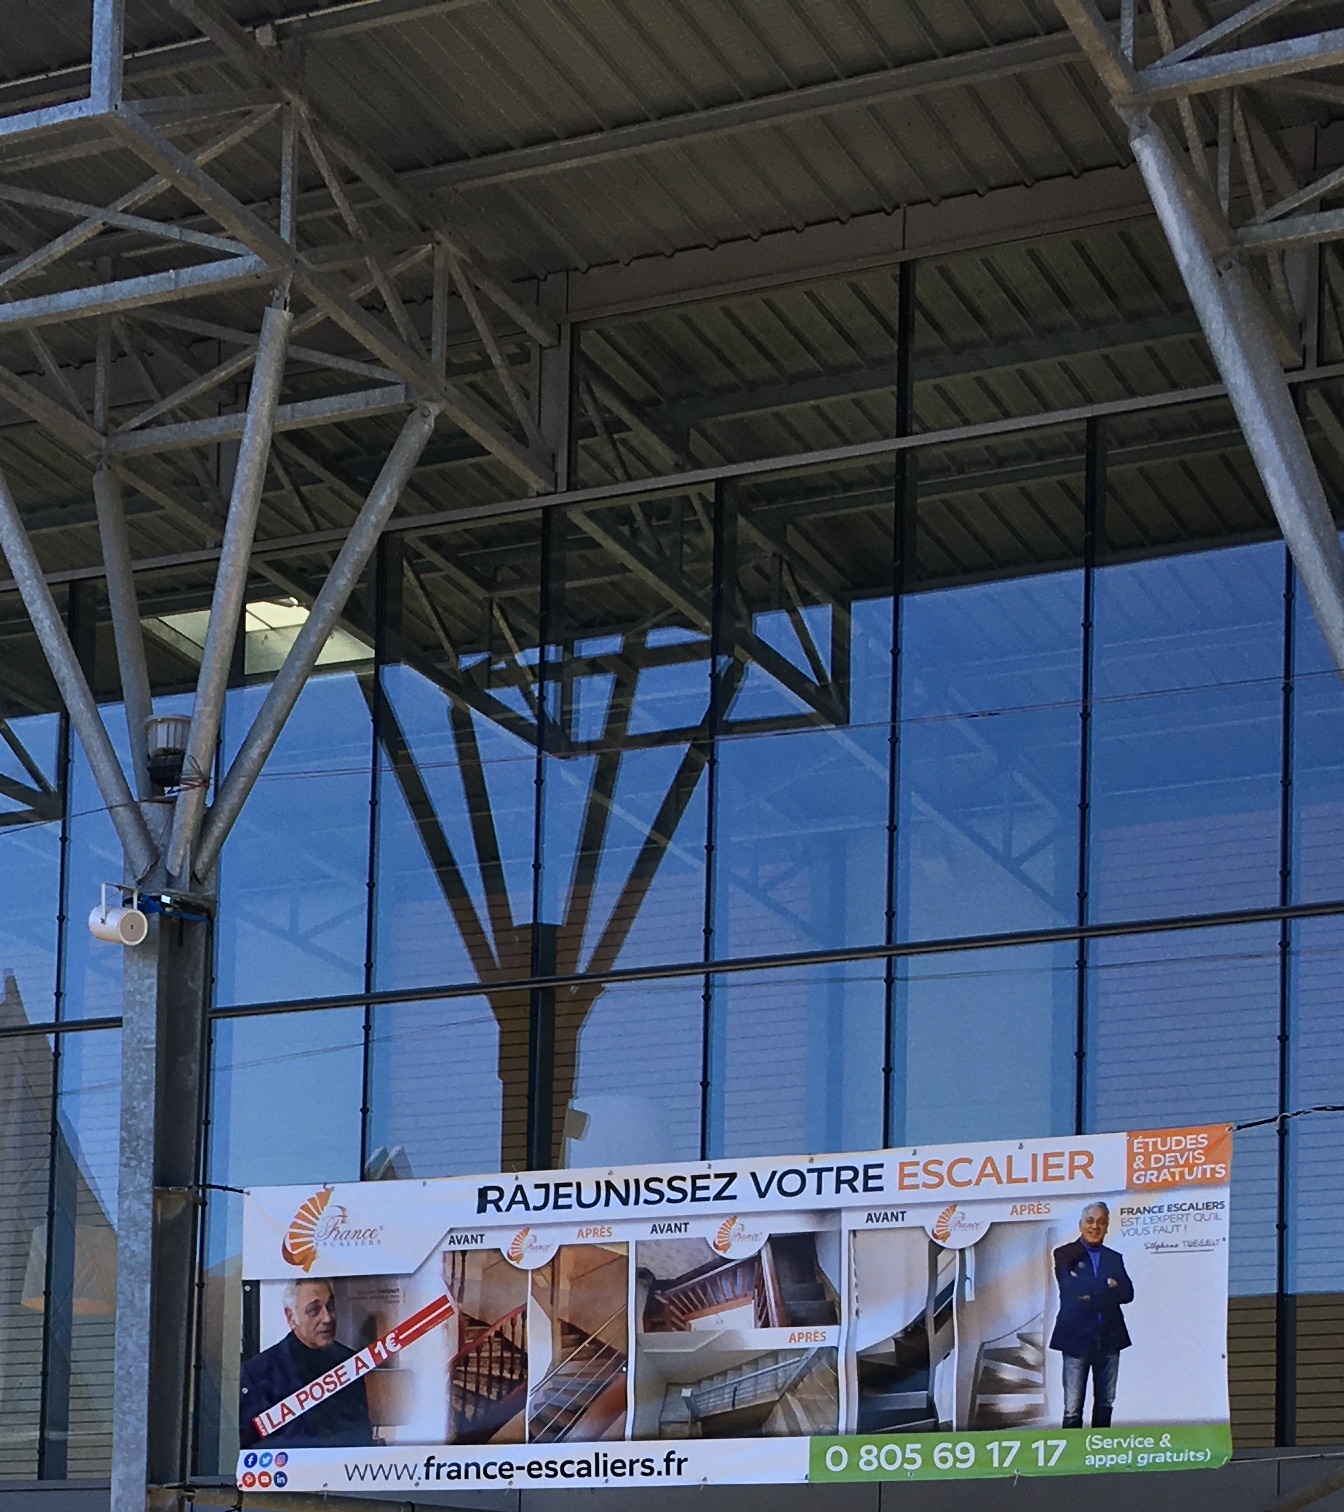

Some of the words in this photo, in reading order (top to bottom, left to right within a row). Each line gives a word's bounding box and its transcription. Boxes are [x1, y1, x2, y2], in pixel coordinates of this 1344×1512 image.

[1133, 1134, 1208, 1152] ÉTUDES
[1133, 1155, 1145, 1169] &
[1150, 1150, 1206, 1168] DEVIS
[476, 1171, 738, 1214] RAJEUNISSEZ
[750, 1163, 884, 1199] VOTRE
[897, 1150, 1095, 1191] ESCALIER
[1132, 1163, 1227, 1184] GRATUITS
[1009, 1201, 1051, 1216] APRÈS
[1120, 1205, 1164, 1216] FRANCE
[1167, 1201, 1226, 1212] ESCALIERS
[316, 1205, 380, 1242] France
[865, 1211, 907, 1224] AVANT
[1121, 1217, 1141, 1227] EST
[1143, 1213, 1190, 1226] L'EXPERT
[576, 1226, 613, 1239] APRÈS
[650, 1222, 690, 1235] AVANT
[1120, 1226, 1150, 1237] VOUS
[1152, 1224, 1182, 1235] FAUT
[448, 1234, 486, 1246] AVANT
[788, 1330, 827, 1343] APRÈS
[265, 1402, 296, 1429] LA
[295, 1364, 352, 1410] POSE
[1085, 1434, 1154, 1450] (Service
[1159, 1433, 1172, 1448] &
[825, 1446, 848, 1472] 0
[859, 1444, 921, 1472] 805
[933, 1442, 975, 1469] 69
[986, 1441, 1021, 1467] 17
[1031, 1439, 1067, 1466] 17
[1085, 1451, 1133, 1467] appel
[1137, 1447, 1212, 1465] gratuits)
[344, 1450, 689, 1481] www.france-escaliers.fr
